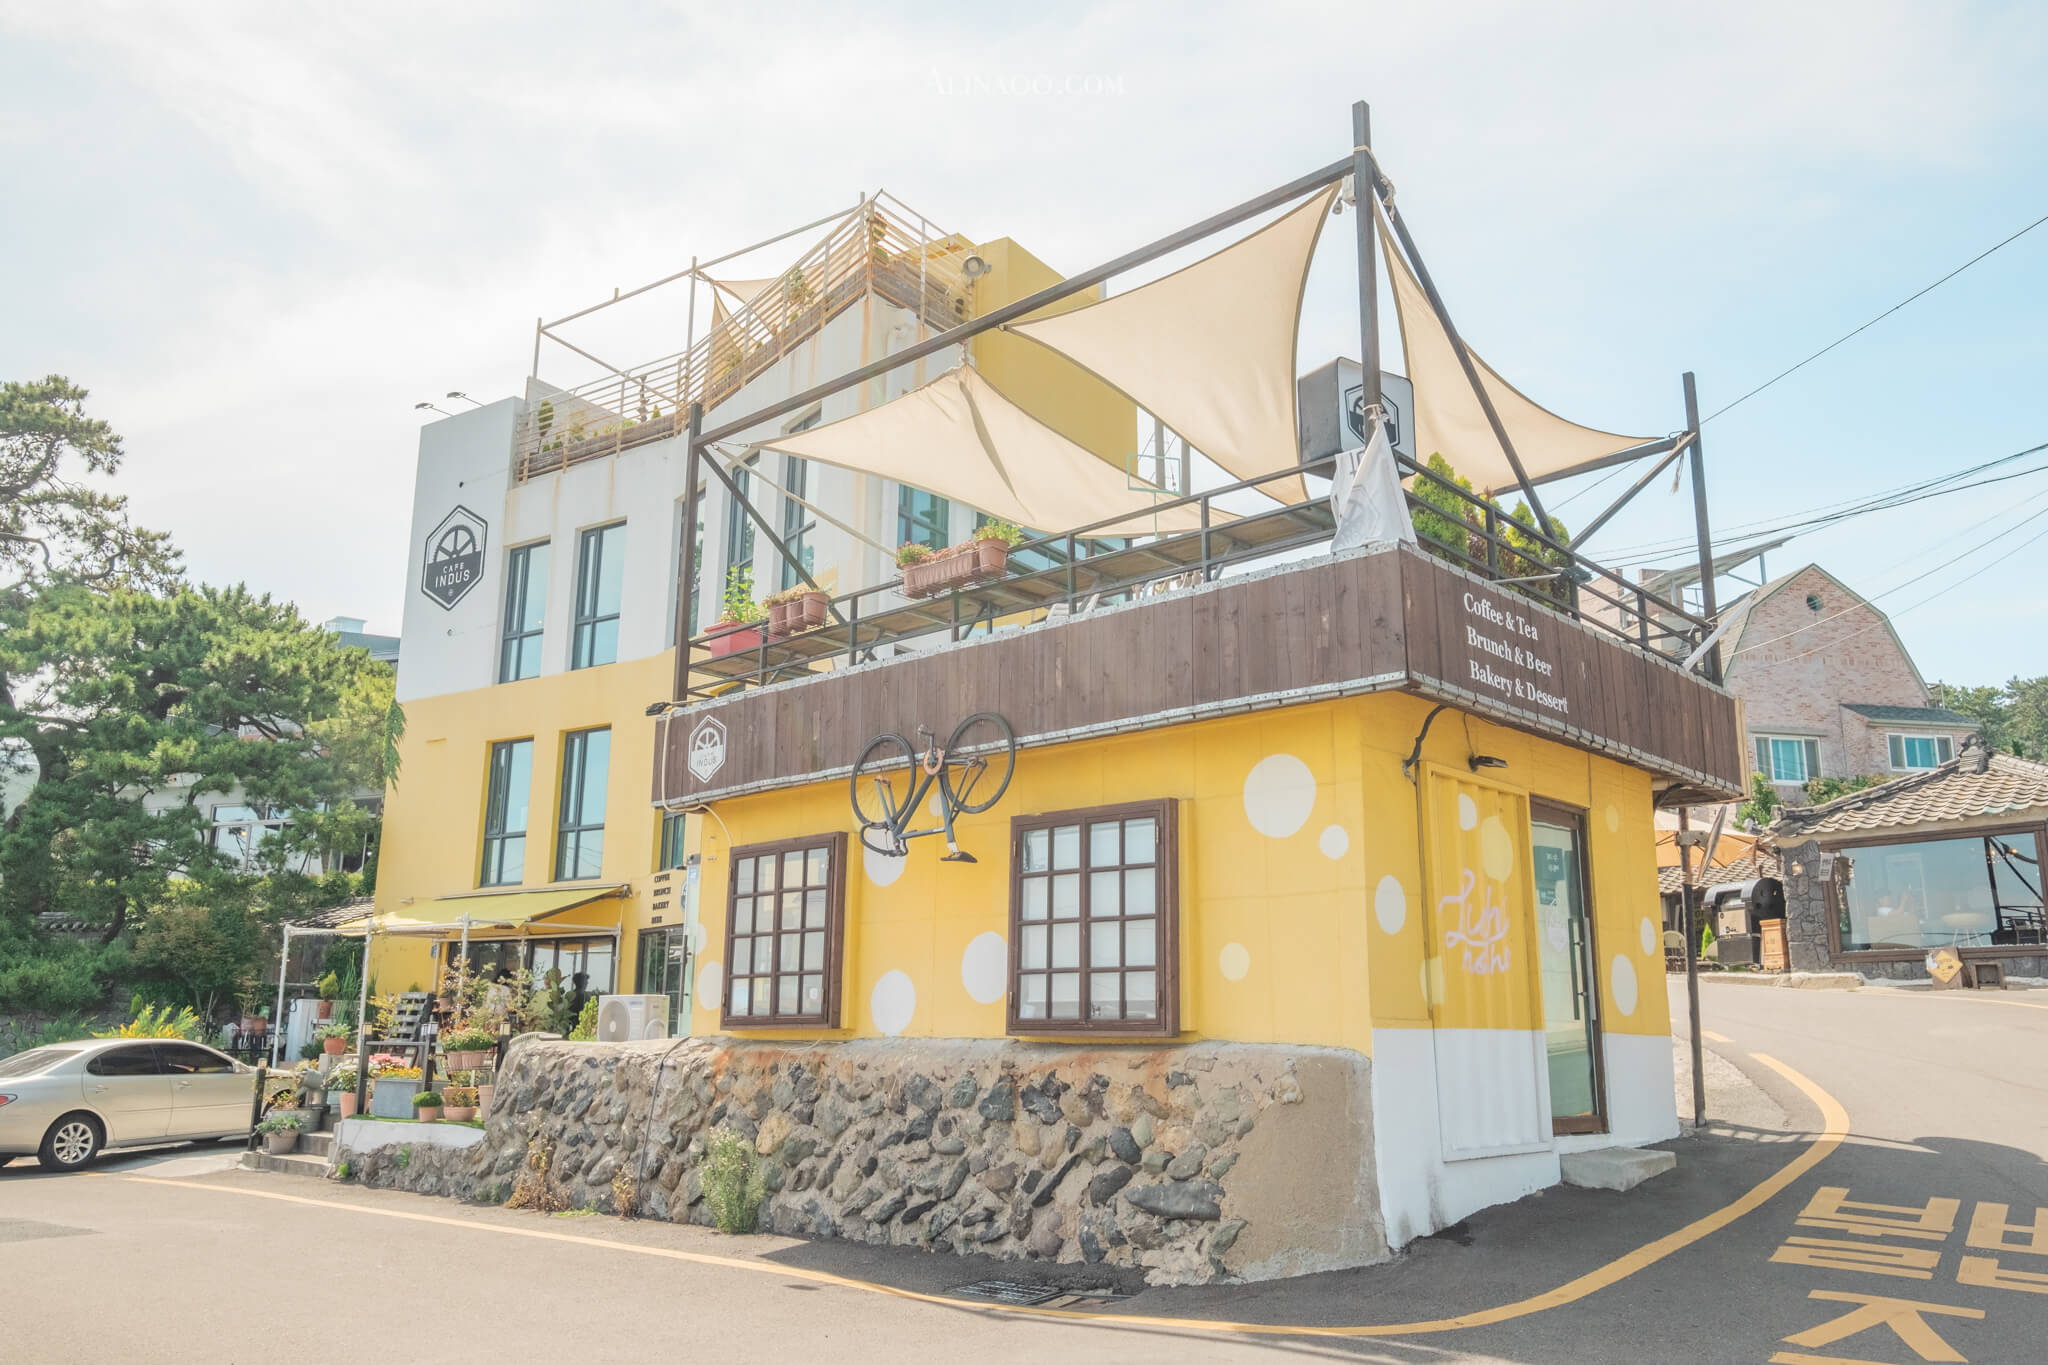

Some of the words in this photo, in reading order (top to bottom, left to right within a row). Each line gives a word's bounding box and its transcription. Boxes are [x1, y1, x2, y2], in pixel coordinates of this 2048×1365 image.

[435, 570, 470, 588] INDUS
[443, 562, 464, 573] CAFE
[1463, 592, 1504, 625] Coffee
[1505, 611, 1515, 632] &
[1516, 616, 1539, 641] Tea
[1466, 625, 1512, 662] Brunch
[1515, 646, 1525, 667] &
[1526, 651, 1552, 677] Beer
[1469, 660, 1513, 698] Bakery
[1515, 678, 1525, 698] &
[1526, 681, 1569, 714] Dessert
